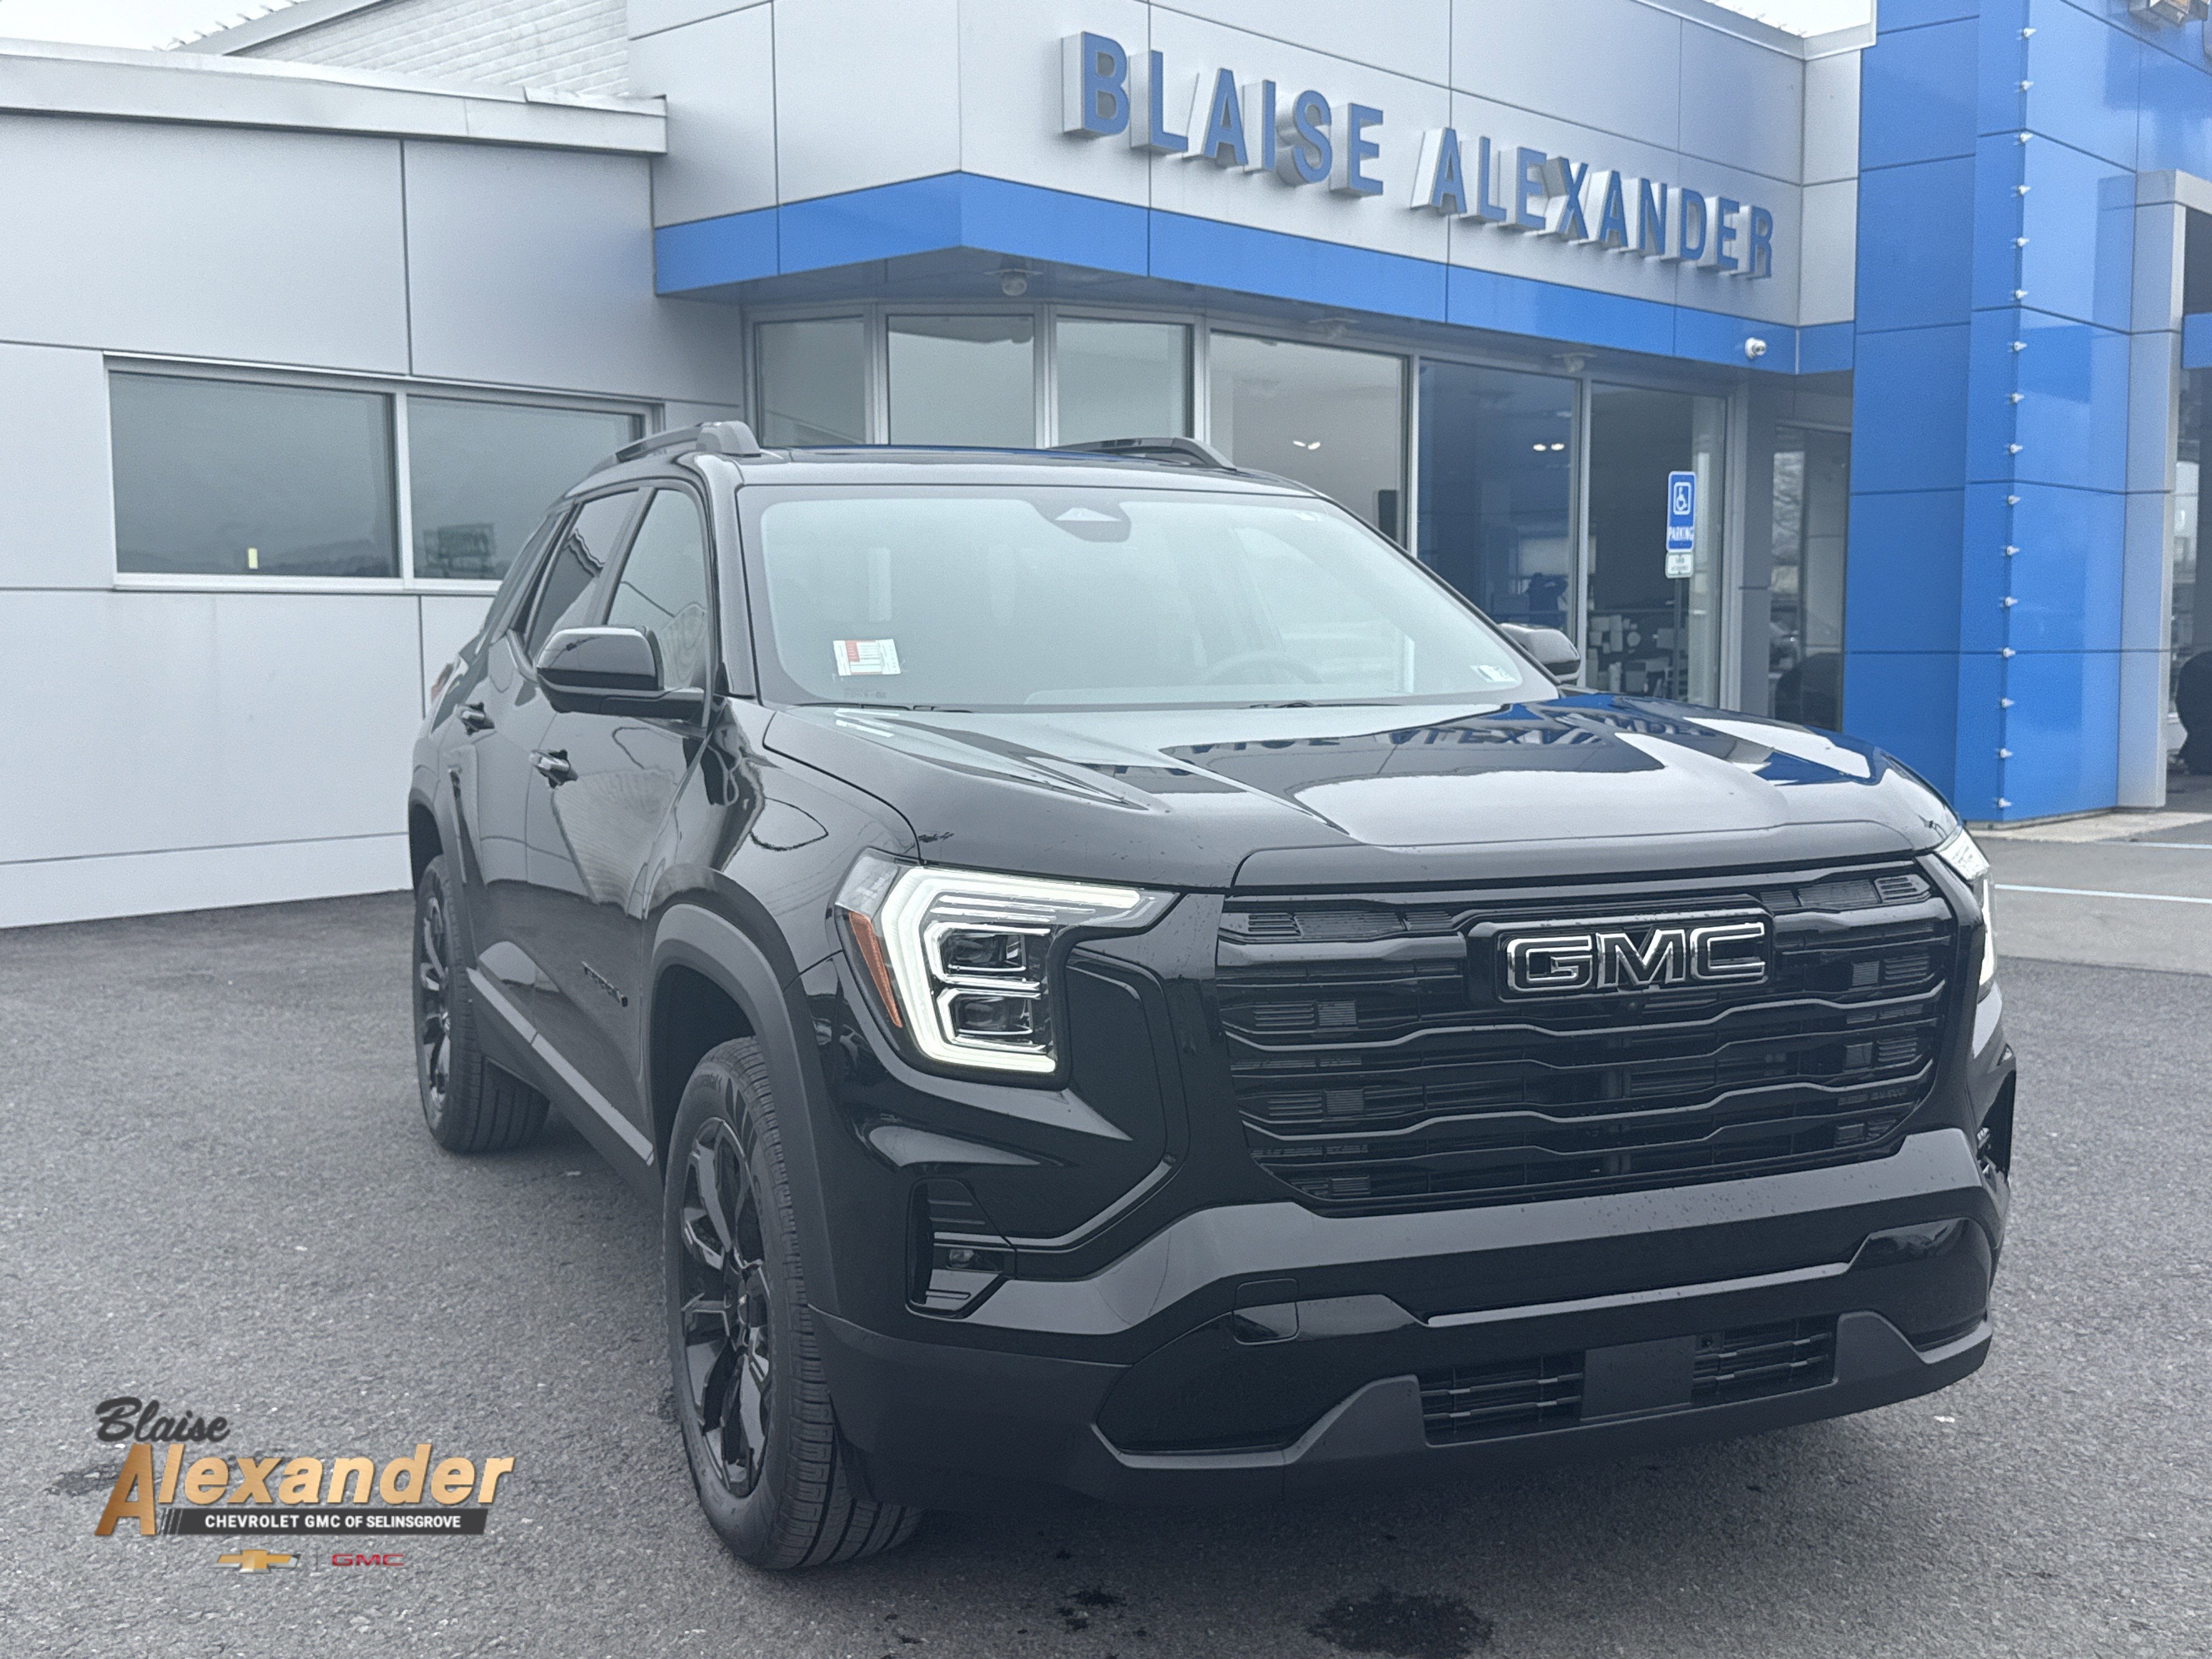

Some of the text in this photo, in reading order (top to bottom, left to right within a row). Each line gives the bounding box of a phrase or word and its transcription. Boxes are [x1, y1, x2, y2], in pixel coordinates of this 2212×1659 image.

[1062, 31, 1773, 279] BLAISE ALEXANDER
[1667, 527, 1694, 541] PARKING
[1506, 922, 1767, 992] GMC
